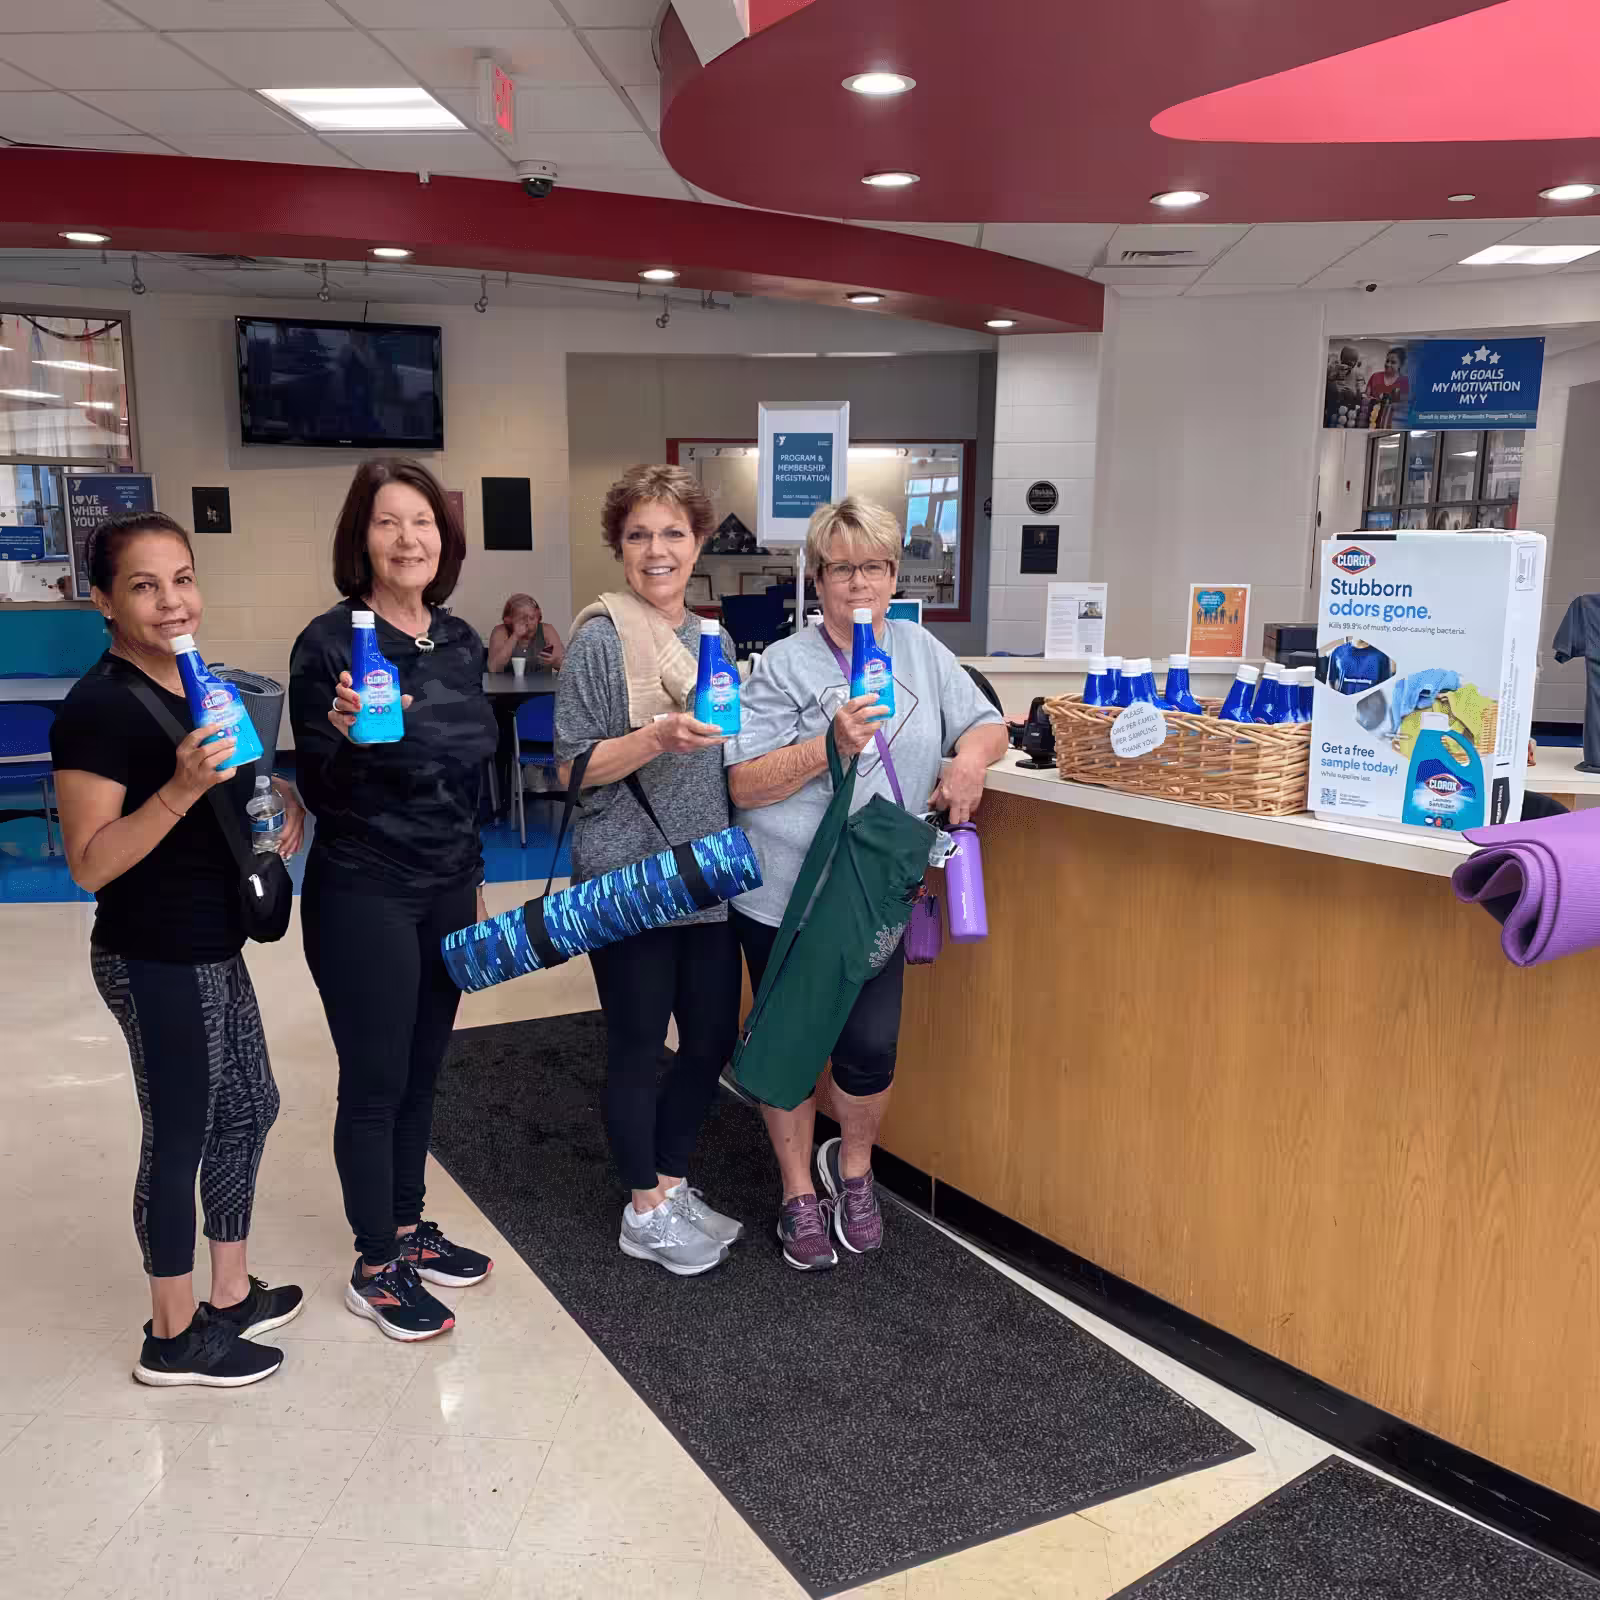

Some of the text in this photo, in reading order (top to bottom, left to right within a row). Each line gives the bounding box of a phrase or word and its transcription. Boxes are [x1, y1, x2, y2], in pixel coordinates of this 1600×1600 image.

[1451, 368, 1504, 381] MY GOALS
[1432, 381, 1520, 393] MY MOTIVATION
[1459, 394, 1488, 405] MY Y
[780, 454, 816, 462] PROGRAM
[777, 464, 826, 472] MEMBERSHIP
[775, 474, 830, 482] REGISTRATION
[72, 506, 109, 516] WHERE
[73, 517, 96, 527] YOU
[1337, 554, 1371, 567] CLOROX
[1330, 577, 1413, 597] Stubborn
[1329, 599, 1431, 622] odors gone.
[1328, 622, 1342, 630] Kills
[1342, 622, 1362, 631] 99.9%
[1392, 626, 1436, 635] odor-causing
[1123, 706, 1144, 719] PLEASE
[1126, 721, 1137, 731] PER
[1121, 742, 1142, 753] THANK
[1321, 742, 1375, 758] Get a free
[1321, 757, 1399, 776] sample today!
[1320, 770, 1337, 778] While
[1337, 772, 1360, 781] supplies
[1428, 778, 1458, 792] CLOROX
